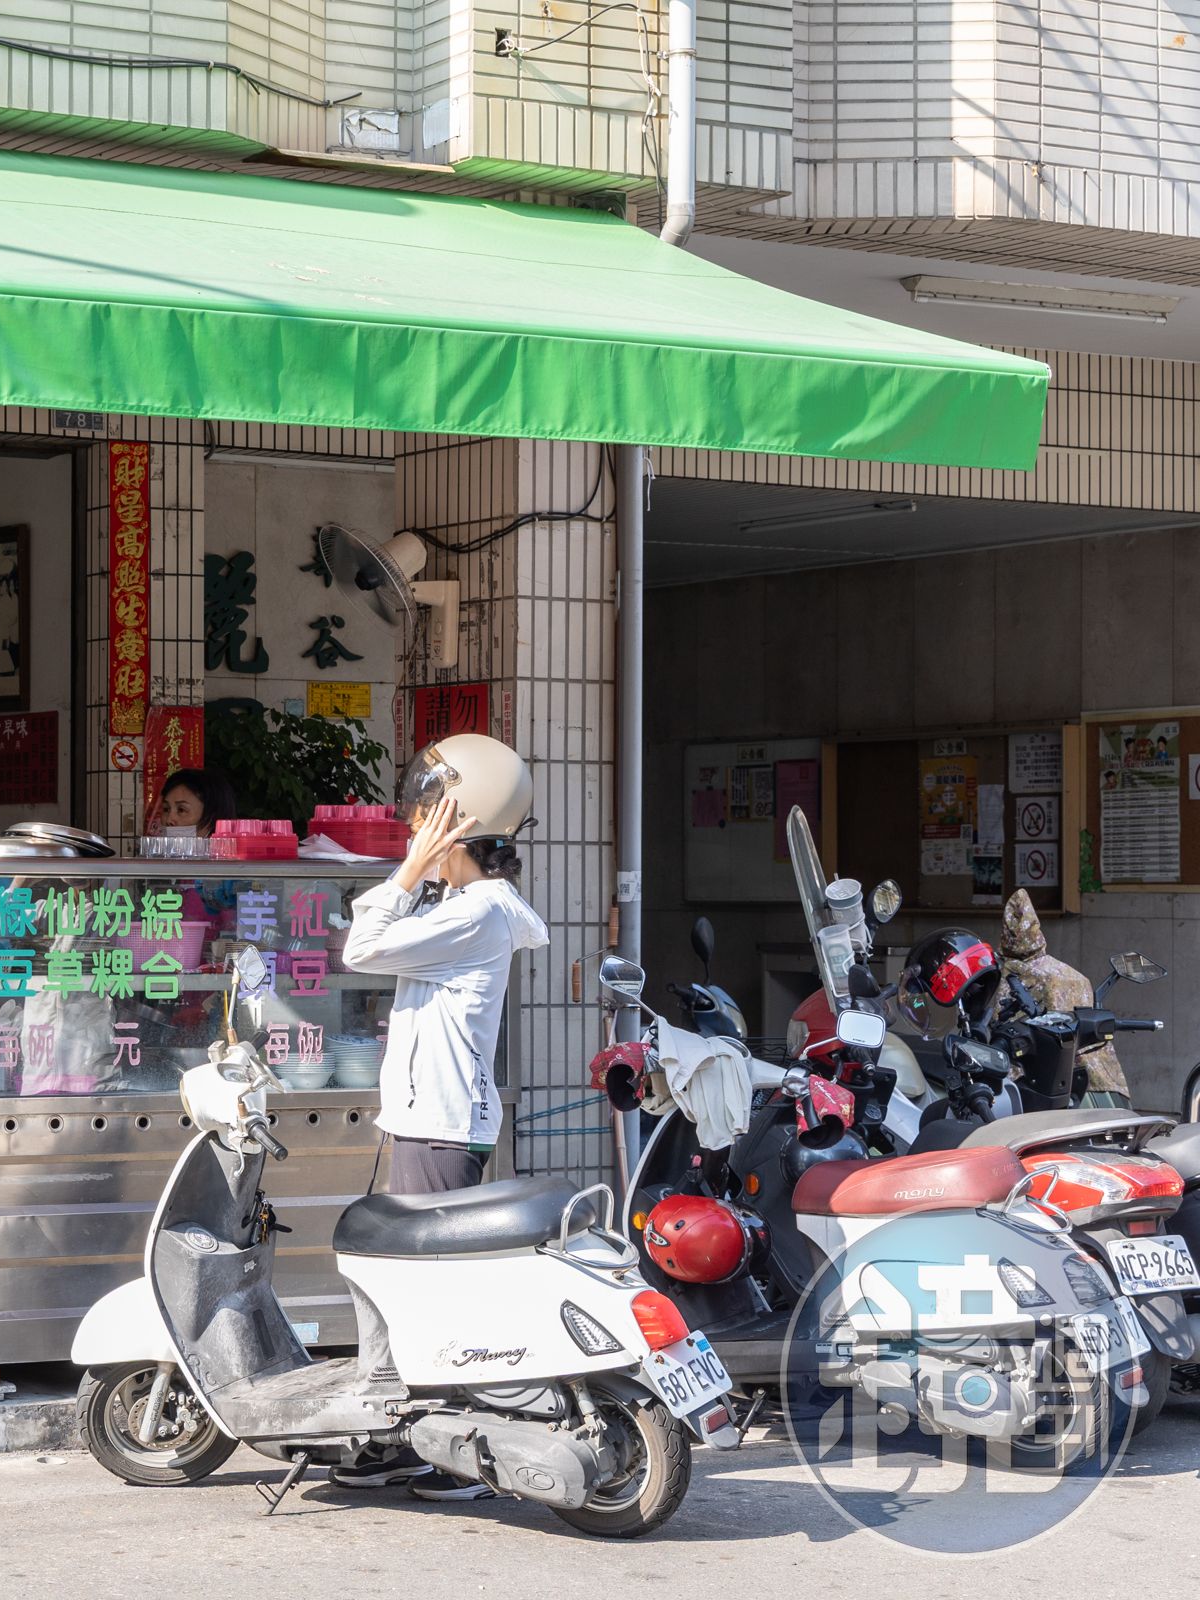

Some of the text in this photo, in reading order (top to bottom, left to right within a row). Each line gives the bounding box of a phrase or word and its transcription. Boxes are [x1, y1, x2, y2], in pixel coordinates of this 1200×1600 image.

[63, 411, 87, 428] 78
[114, 456, 146, 697] 財星高照生意旺
[112, 1021, 141, 1067] 元
[265, 1020, 324, 1065] 每碗
[894, 1187, 945, 1200] many
[657, 1351, 725, 1407] 587-EVC
